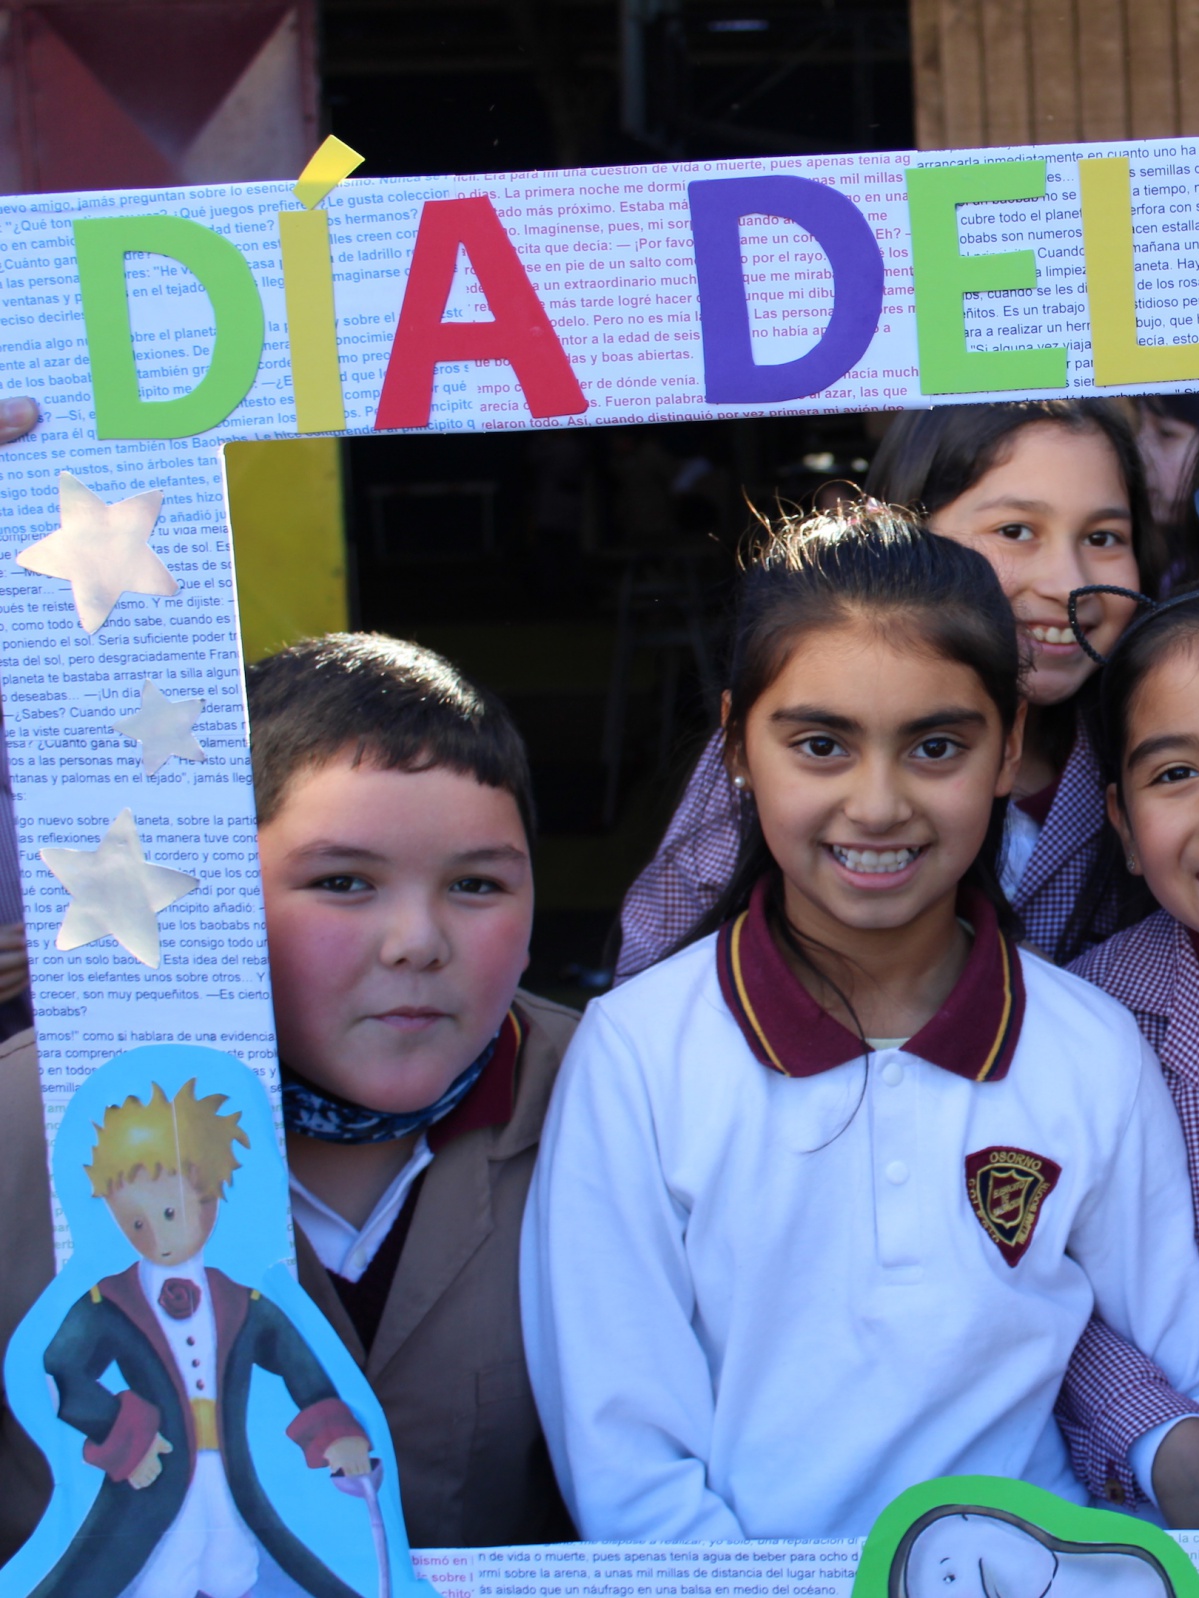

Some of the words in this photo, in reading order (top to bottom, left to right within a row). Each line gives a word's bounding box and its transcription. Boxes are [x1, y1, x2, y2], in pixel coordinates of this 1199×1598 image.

[1153, 147, 1177, 158] uno
[1180, 144, 1197, 156] ha
[715, 159, 766, 171] muerte,
[770, 158, 803, 172] pues
[806, 156, 855, 170] apenas
[858, 153, 891, 166] tenía
[1139, 163, 1191, 178] semillas
[118, 191, 186, 209] preguntan
[188, 187, 227, 200] sobre
[230, 185, 243, 197] lo
[504, 187, 521, 199] La
[524, 185, 575, 201] primera
[579, 182, 620, 196] noche
[623, 184, 644, 194] me
[647, 179, 686, 193] dormí
[344, 207, 419, 225] hermanos?
[524, 222, 604, 238] Imagínense,
[608, 222, 644, 235] pues,
[647, 218, 664, 231] mi
[73, 134, 588, 441] DÍA
[563, 275, 657, 290] extraordinario
[549, 297, 577, 309] más
[580, 295, 614, 308] tarde
[618, 293, 652, 309] logré
[655, 293, 693, 305] hacer
[1169, 315, 1194, 329] que
[601, 351, 634, 363] boas
[637, 349, 694, 361] abiertas.
[136, 364, 189, 380] también
[596, 377, 613, 389] de
[616, 375, 657, 388] dónde
[660, 374, 700, 387] venía.
[68, 446, 112, 458] comen
[114, 440, 166, 454] también
[115, 462, 144, 473] sino
[147, 457, 195, 470] árboles
[196, 456, 218, 467] tan
[148, 475, 210, 488] elefantes,
[1, 636, 57, 652] poniendo
[59, 636, 71, 648] el
[73, 634, 96, 647] sol.
[97, 633, 130, 646] Sería
[132, 632, 189, 645] suficiente
[191, 631, 226, 645] poder
[1, 673, 45, 687] planeta
[46, 673, 60, 684] te
[61, 670, 110, 683] bastaba
[112, 669, 164, 681] arrastrar
[165, 668, 177, 680] la
[179, 667, 203, 679] silla
[36, 831, 102, 844] reflexiones
[67, 971, 85, 983] los
[86, 970, 141, 983] elefantes
[143, 973, 173, 983] unos
[175, 971, 209, 983] sobre
[82, 990, 104, 1000] son
[107, 991, 132, 1003] muy
[133, 988, 204, 1002] pequeñitos.
[989, 1151, 1042, 1171] OSORNO
[592, 1553, 621, 1564] pues
[623, 1553, 667, 1564] apenas
[669, 1551, 700, 1562] tenía
[702, 1553, 732, 1565] agua
[734, 1551, 750, 1562] de
[751, 1551, 787, 1563] beber
[789, 1553, 817, 1564] para
[819, 1551, 849, 1563] ocho
[582, 1583, 635, 1598] náufrago
[636, 1586, 653, 1596] en
[655, 1586, 678, 1596] una
[680, 1584, 712, 1596] balsa
